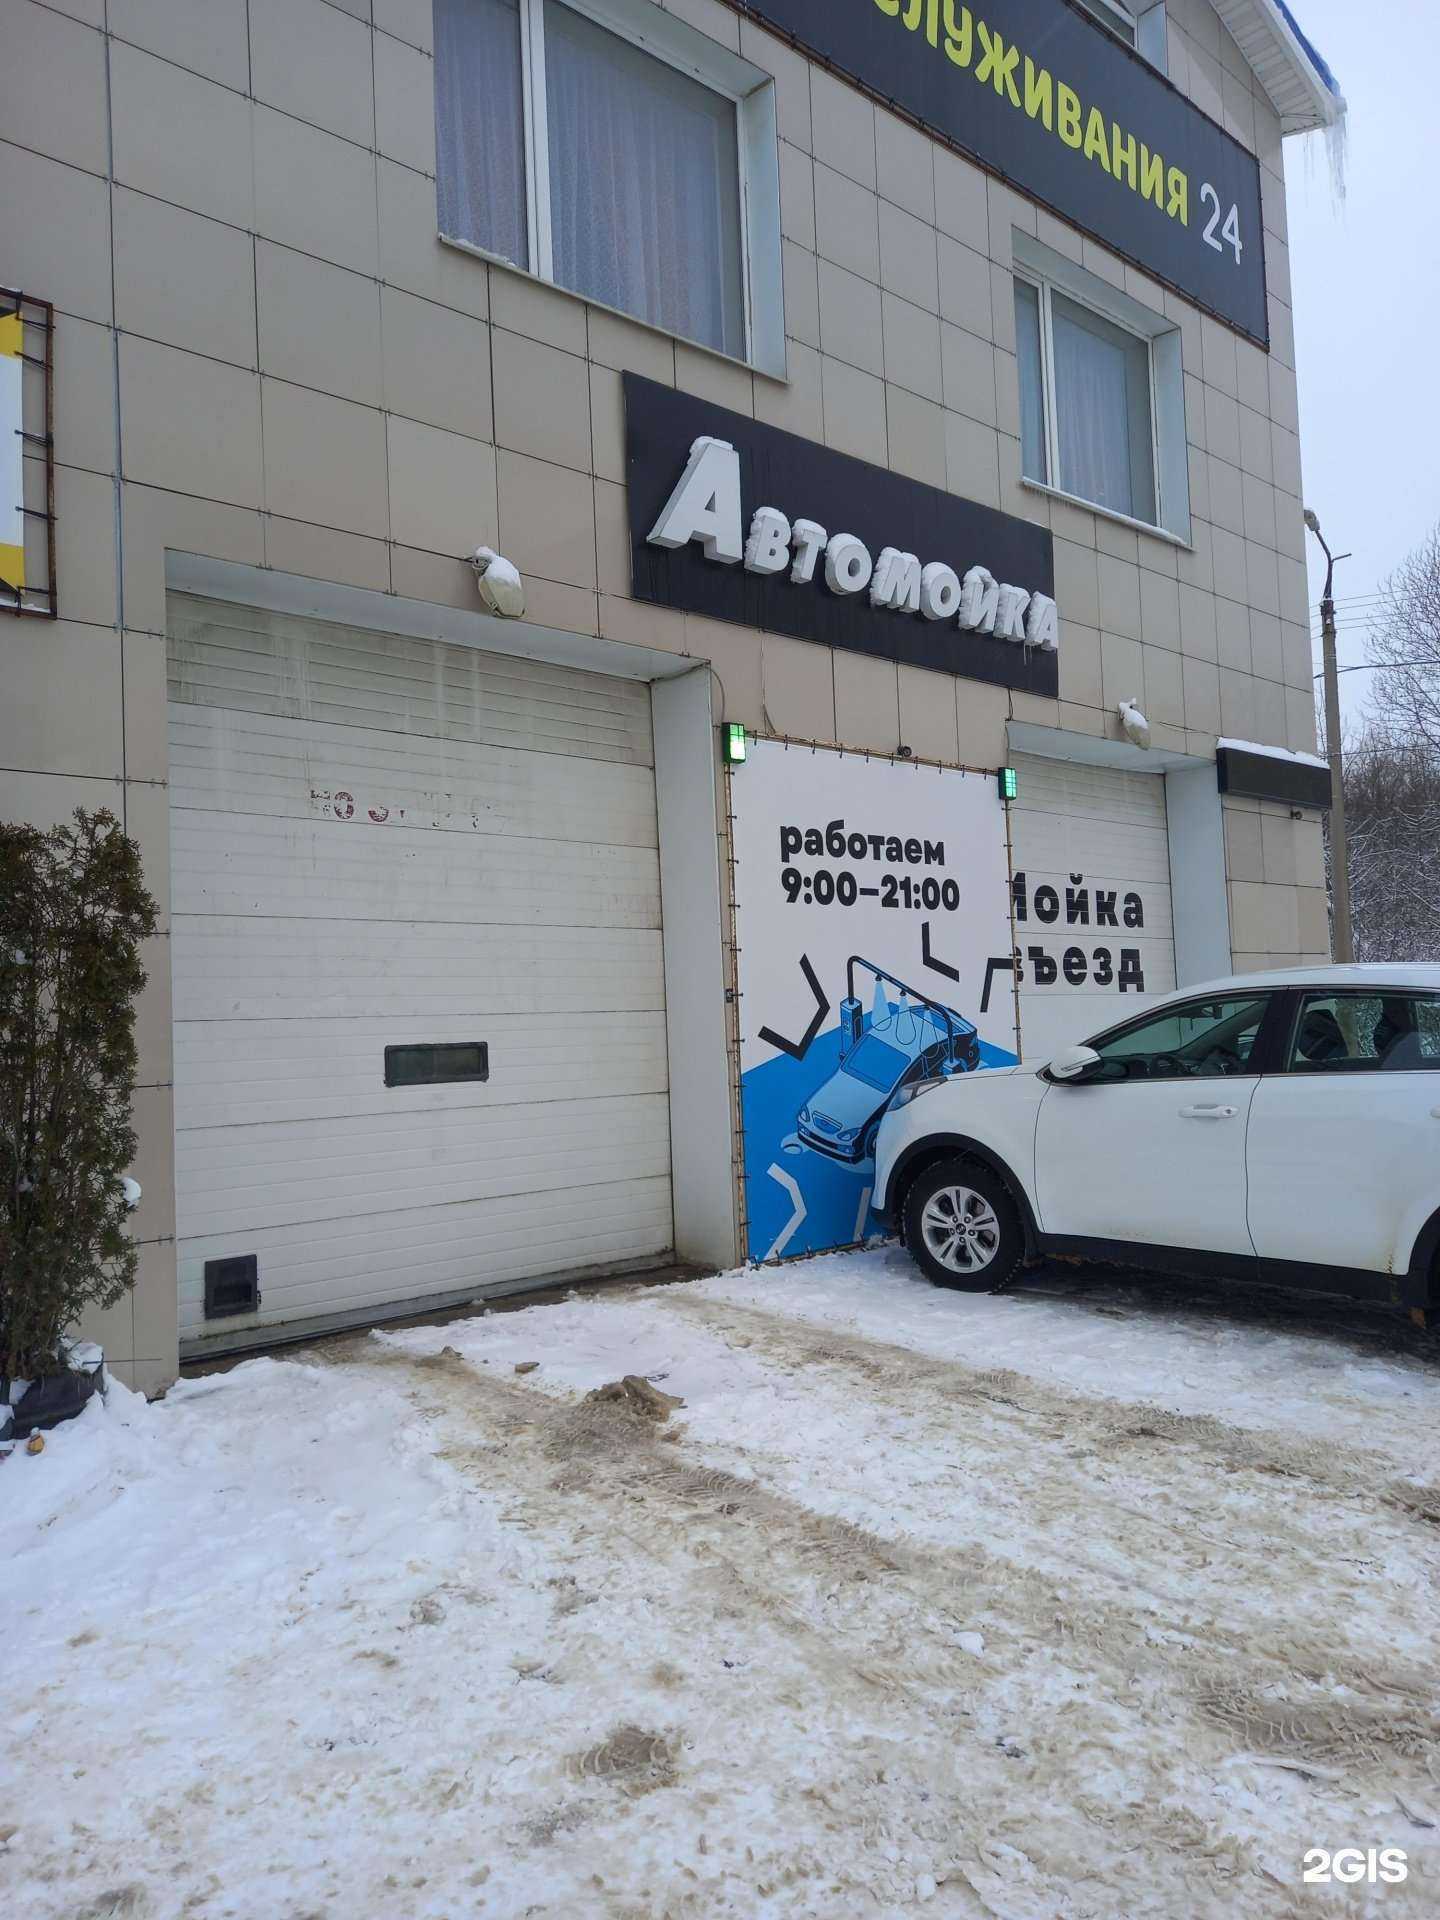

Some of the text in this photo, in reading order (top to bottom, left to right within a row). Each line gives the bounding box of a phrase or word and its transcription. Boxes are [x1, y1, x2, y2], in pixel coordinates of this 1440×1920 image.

[874, 0, 1242, 265] ЛУЖИВАНИЯ 24
[780, 819, 945, 865] работаем
